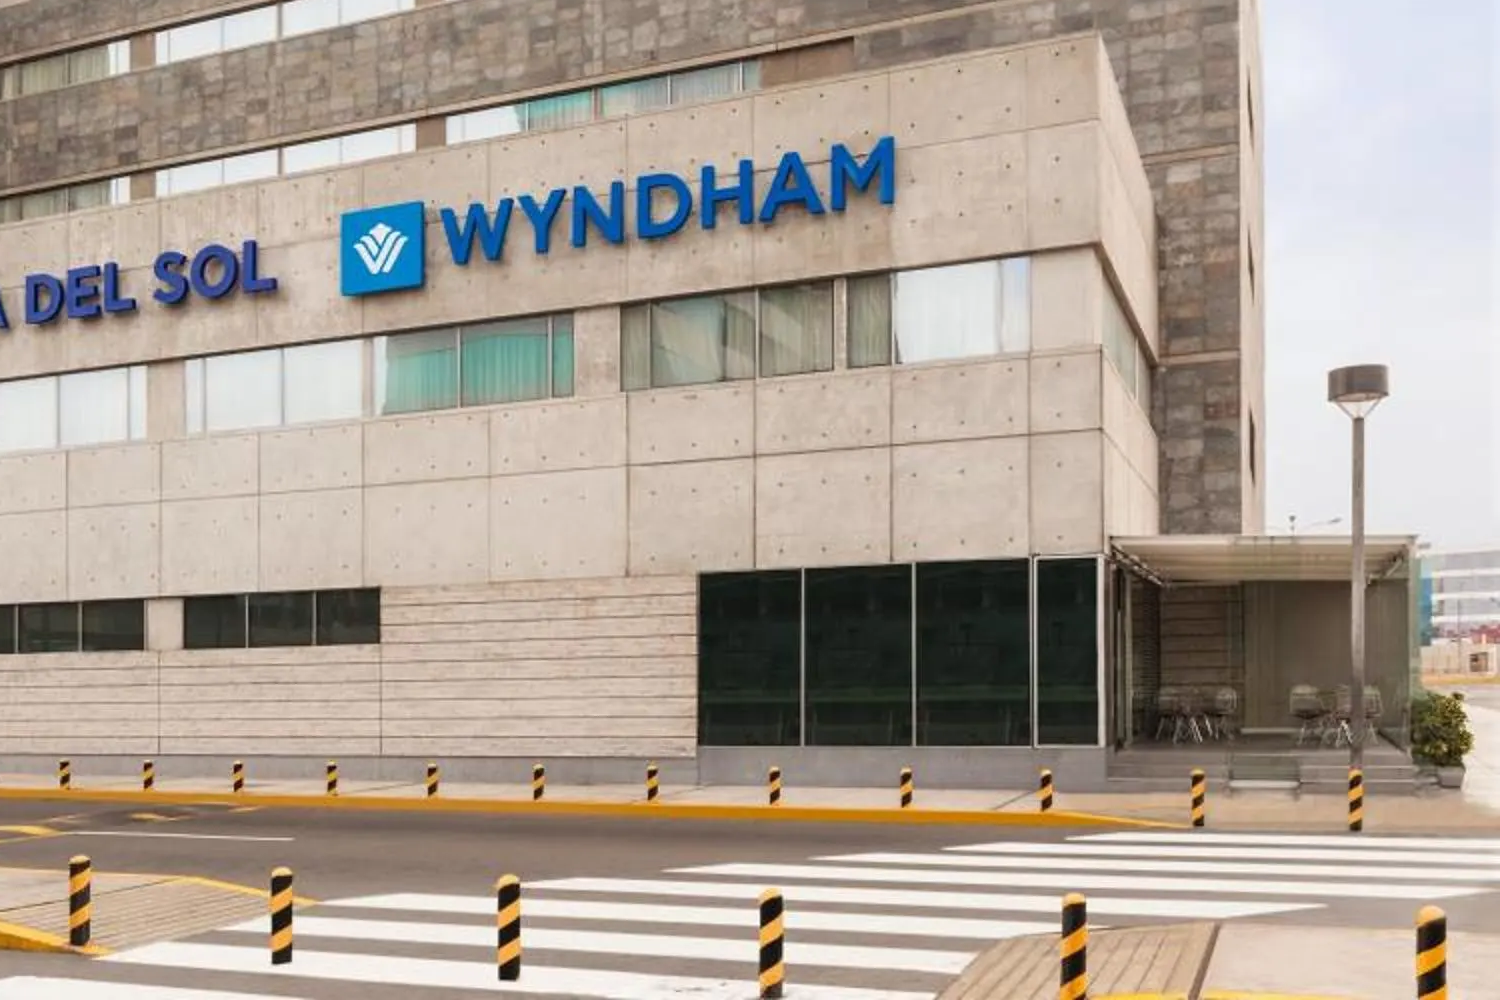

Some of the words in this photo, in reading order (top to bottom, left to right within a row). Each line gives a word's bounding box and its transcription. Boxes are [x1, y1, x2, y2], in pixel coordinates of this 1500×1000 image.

[439, 136, 896, 266] WYNDHAM
[25, 261, 137, 325] DEL
[153, 239, 279, 305] SOL
